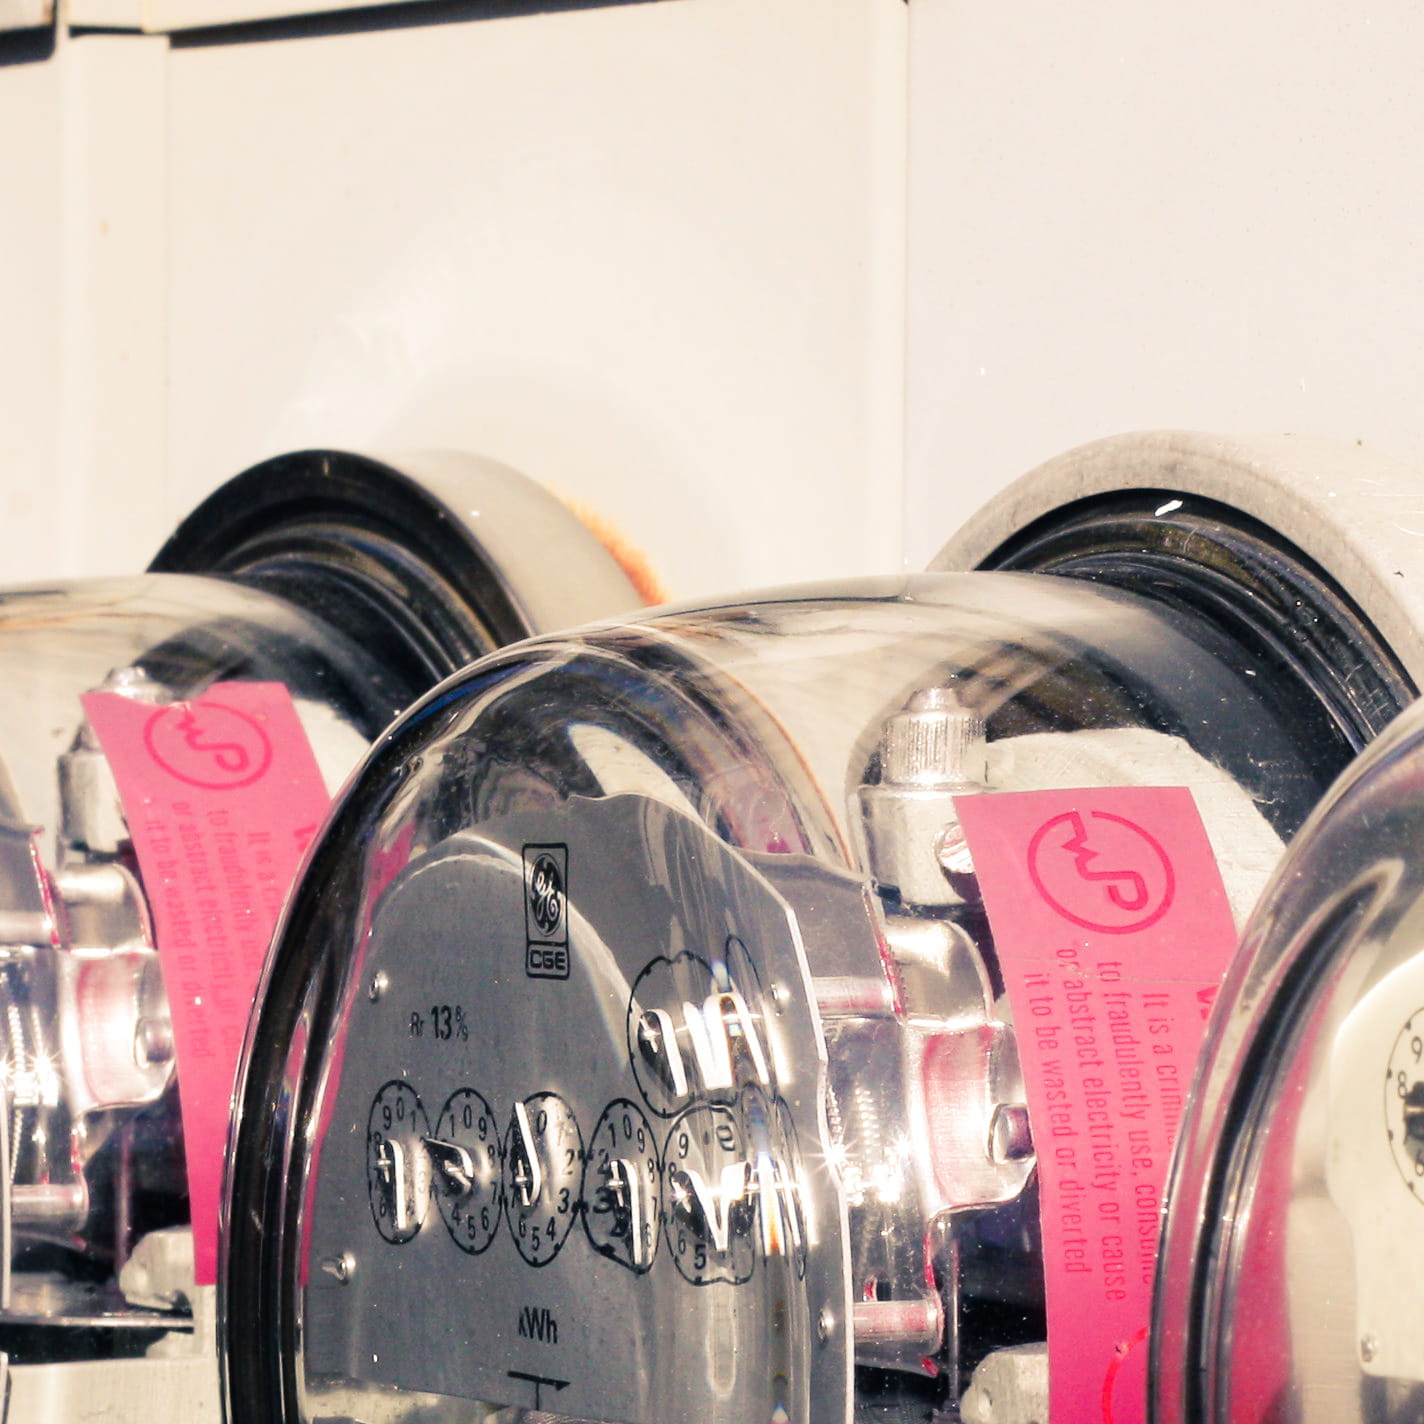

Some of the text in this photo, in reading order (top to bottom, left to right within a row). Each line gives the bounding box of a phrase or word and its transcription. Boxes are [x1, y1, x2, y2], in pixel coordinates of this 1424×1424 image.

[530, 949, 566, 970] CGE
[1095, 961, 1125, 983] to
[1142, 993, 1172, 1012] It
[1147, 1017, 1177, 1035] is
[1102, 992, 1152, 1121] fraudulently
[1152, 1044, 1175, 1055] a
[1411, 1036, 1424, 1065] 9
[1397, 1071, 1409, 1100] 8
[383, 1105, 392, 1131] 9
[396, 1097, 404, 1121] 0
[463, 1104, 472, 1129] 0
[478, 1117, 487, 1142] 9
[536, 1110, 548, 1136] 0
[623, 1114, 632, 1140] 0
[1023, 972, 1091, 1274] it to be wasted or diverted
[1055, 948, 1128, 1302] or abstract electricity or cause
[637, 1128, 646, 1153] 9
[679, 1133, 689, 1159] 9
[1126, 1130, 1158, 1178] use,
[557, 1188, 571, 1214] 3
[451, 1203, 461, 1226] 4
[480, 1207, 490, 1231] 6
[467, 1216, 476, 1240] 5
[531, 1226, 541, 1252] 5
[546, 1216, 557, 1242] 4
[694, 1243, 707, 1270] 5
[518, 1306, 559, 1345] kWh
